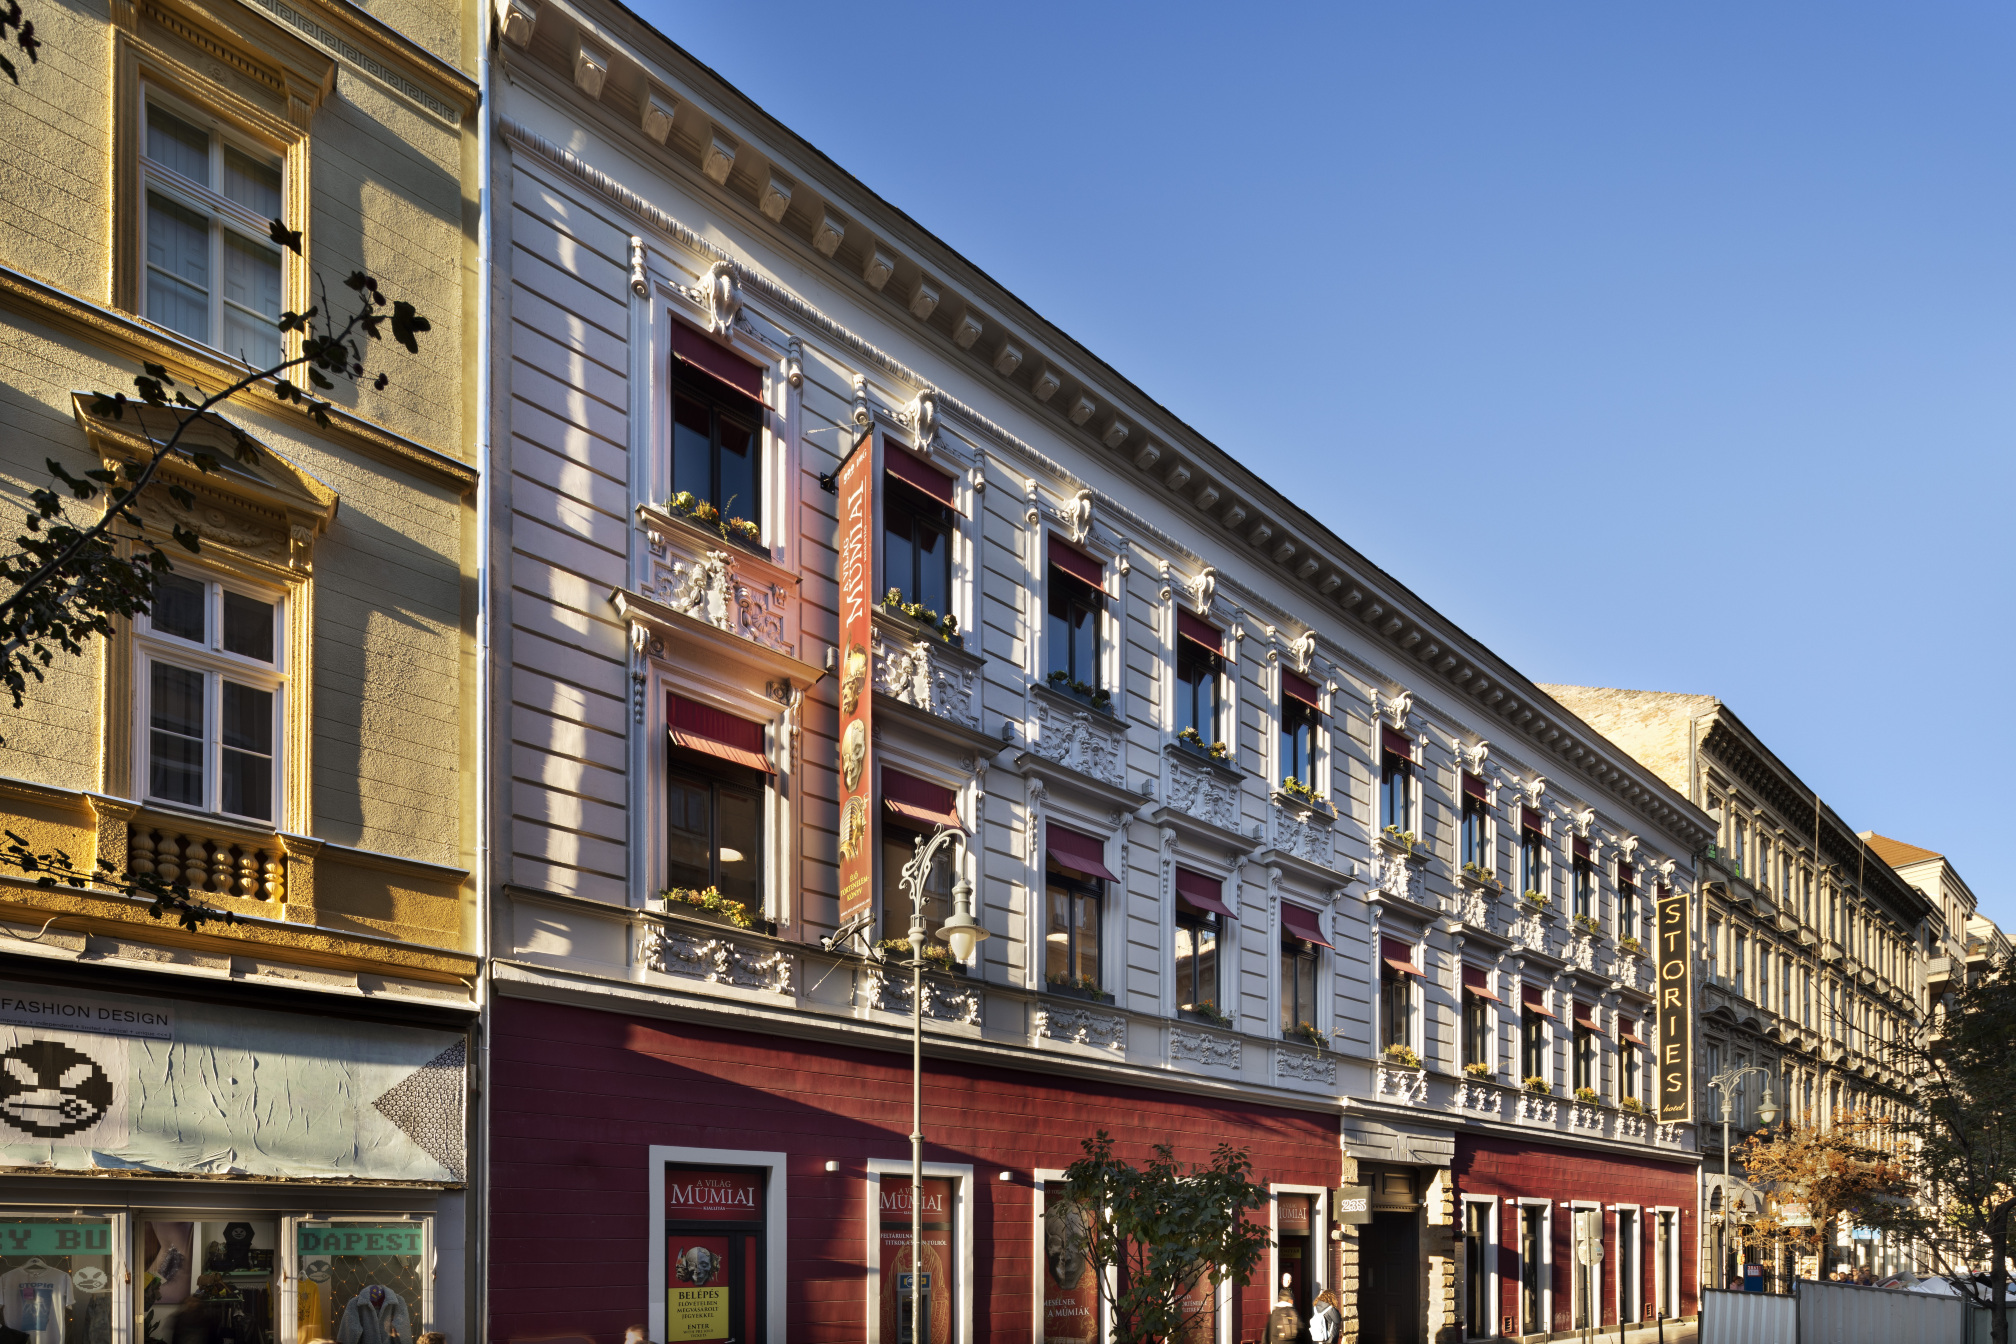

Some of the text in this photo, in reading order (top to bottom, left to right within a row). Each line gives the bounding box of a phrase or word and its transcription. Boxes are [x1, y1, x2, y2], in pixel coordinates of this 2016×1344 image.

[1662, 904, 1685, 1092] STORIES
[1, 998, 168, 1026] FASHION DESIGN
[1663, 1102, 1685, 1112] hotel
[705, 1179, 731, 1188] VILÁG
[1341, 1199, 1367, 1213] 235
[300, 1233, 421, 1251] DAPEST
[678, 1289, 720, 1300] BELÉPÉS
